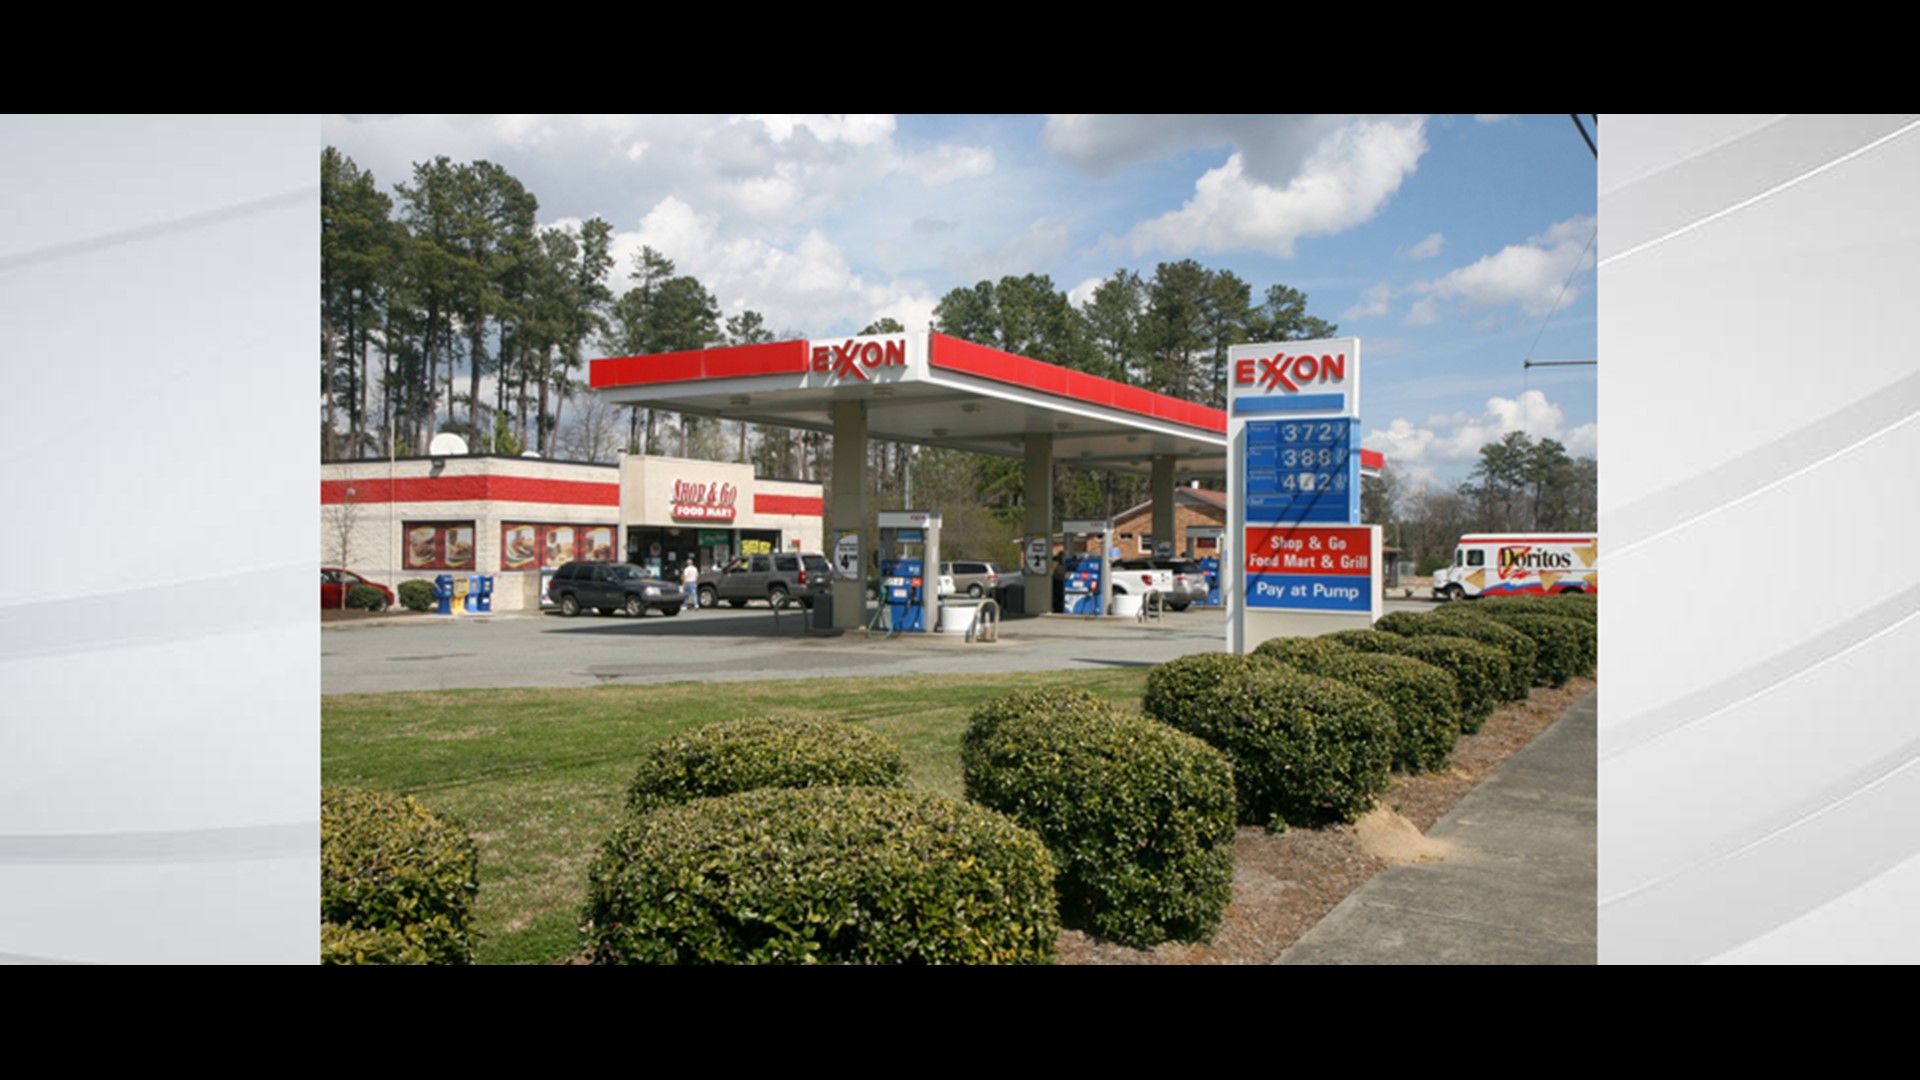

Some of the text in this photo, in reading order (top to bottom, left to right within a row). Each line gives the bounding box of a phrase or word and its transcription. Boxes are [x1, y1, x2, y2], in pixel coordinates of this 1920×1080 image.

[812, 339, 906, 380] EXXON
[1235, 352, 1345, 392] EXXON
[673, 478, 706, 503] SHOP
[677, 505, 732, 518] FOOD MART
[1271, 536, 1347, 552] Shop & Go
[1249, 553, 1368, 569] Food Mart & Grill
[1500, 547, 1572, 568] Doritos
[1256, 581, 1359, 601] Pay at Pump
